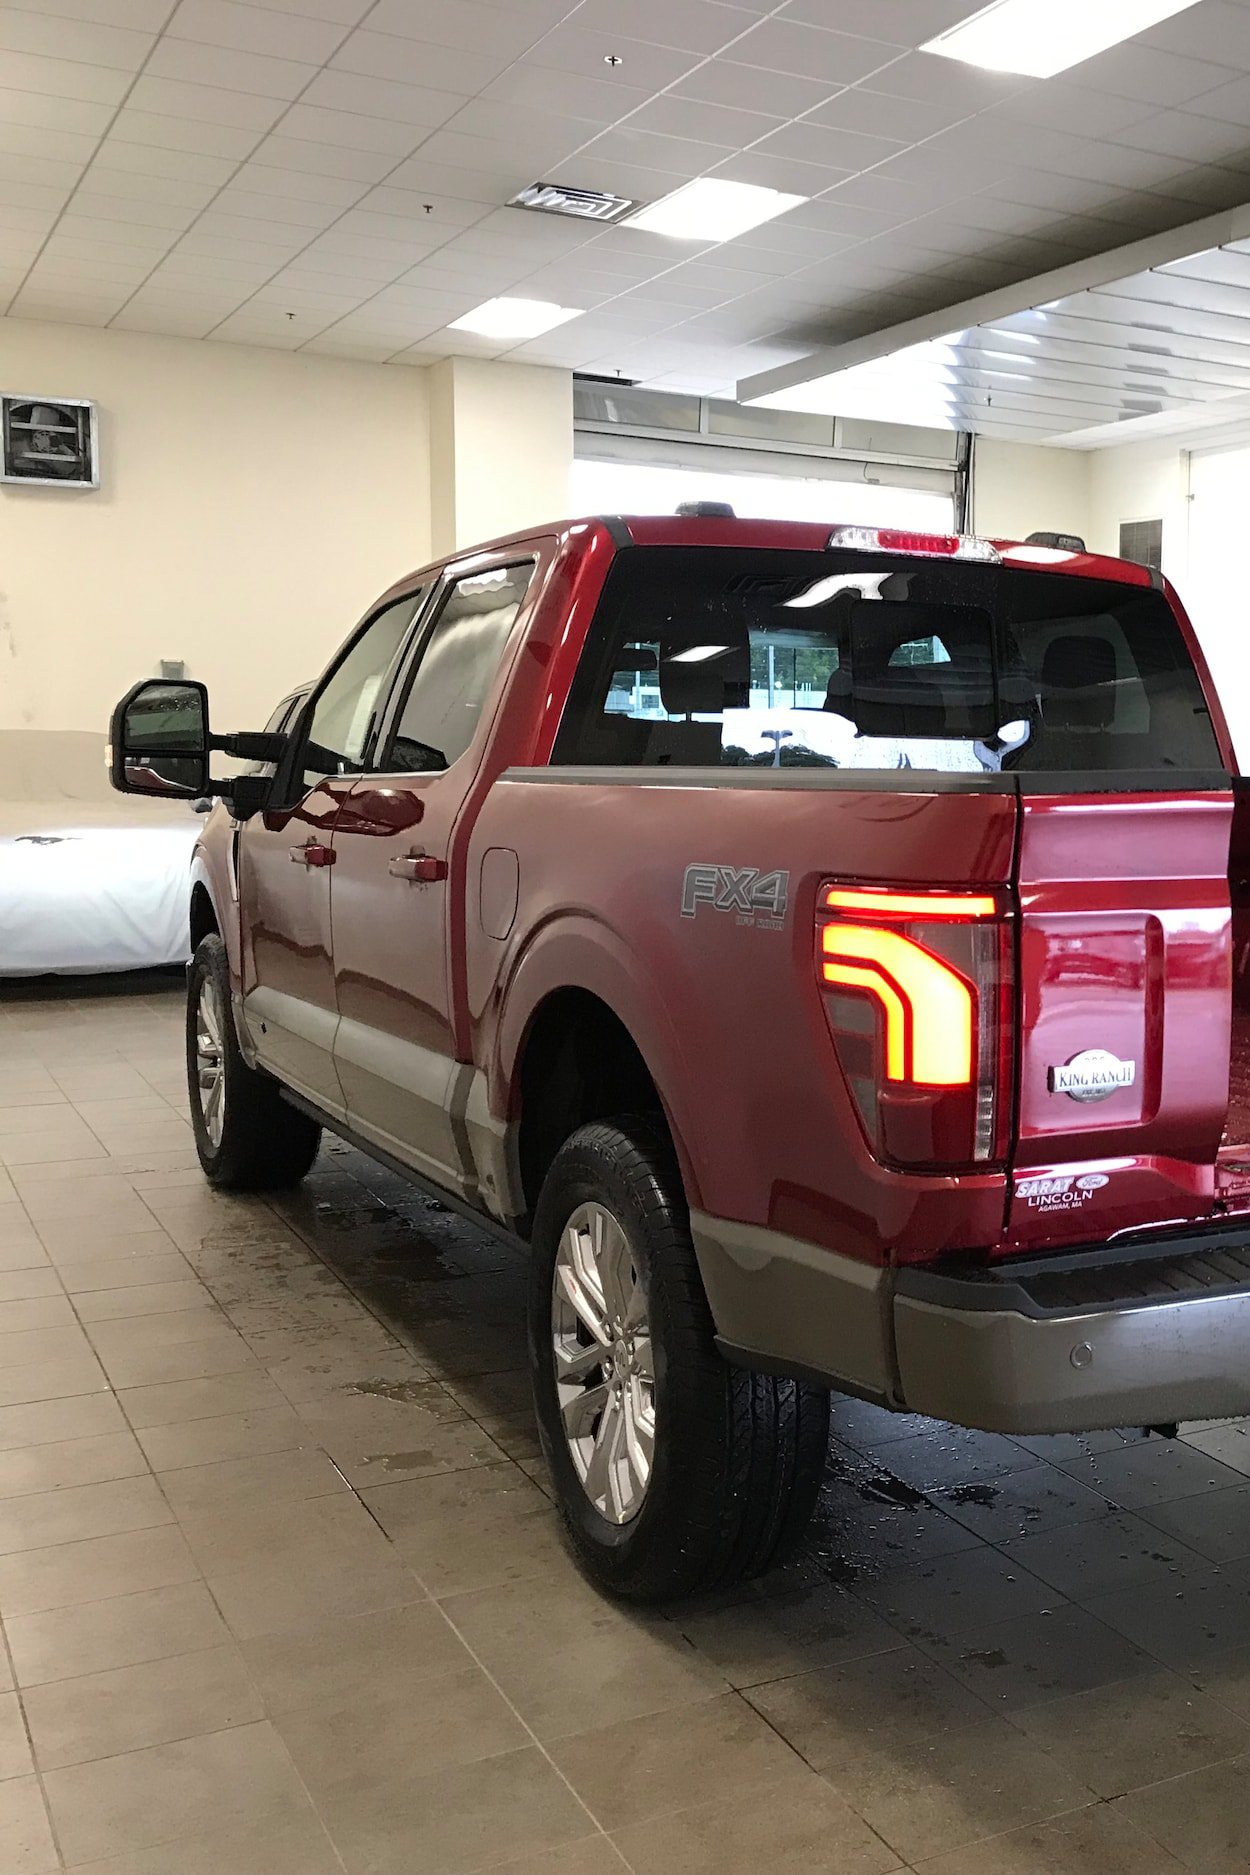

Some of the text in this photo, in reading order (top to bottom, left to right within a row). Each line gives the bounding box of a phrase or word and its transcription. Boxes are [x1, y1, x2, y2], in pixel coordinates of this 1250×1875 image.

[680, 862, 790, 919] FX4
[1058, 1067, 1132, 1088] KING RANCH
[1015, 1176, 1106, 1198] SARAT Ford
[1027, 1189, 1093, 1207] LINCOLN
[1038, 1200, 1083, 1213] AGAWAM, MA
